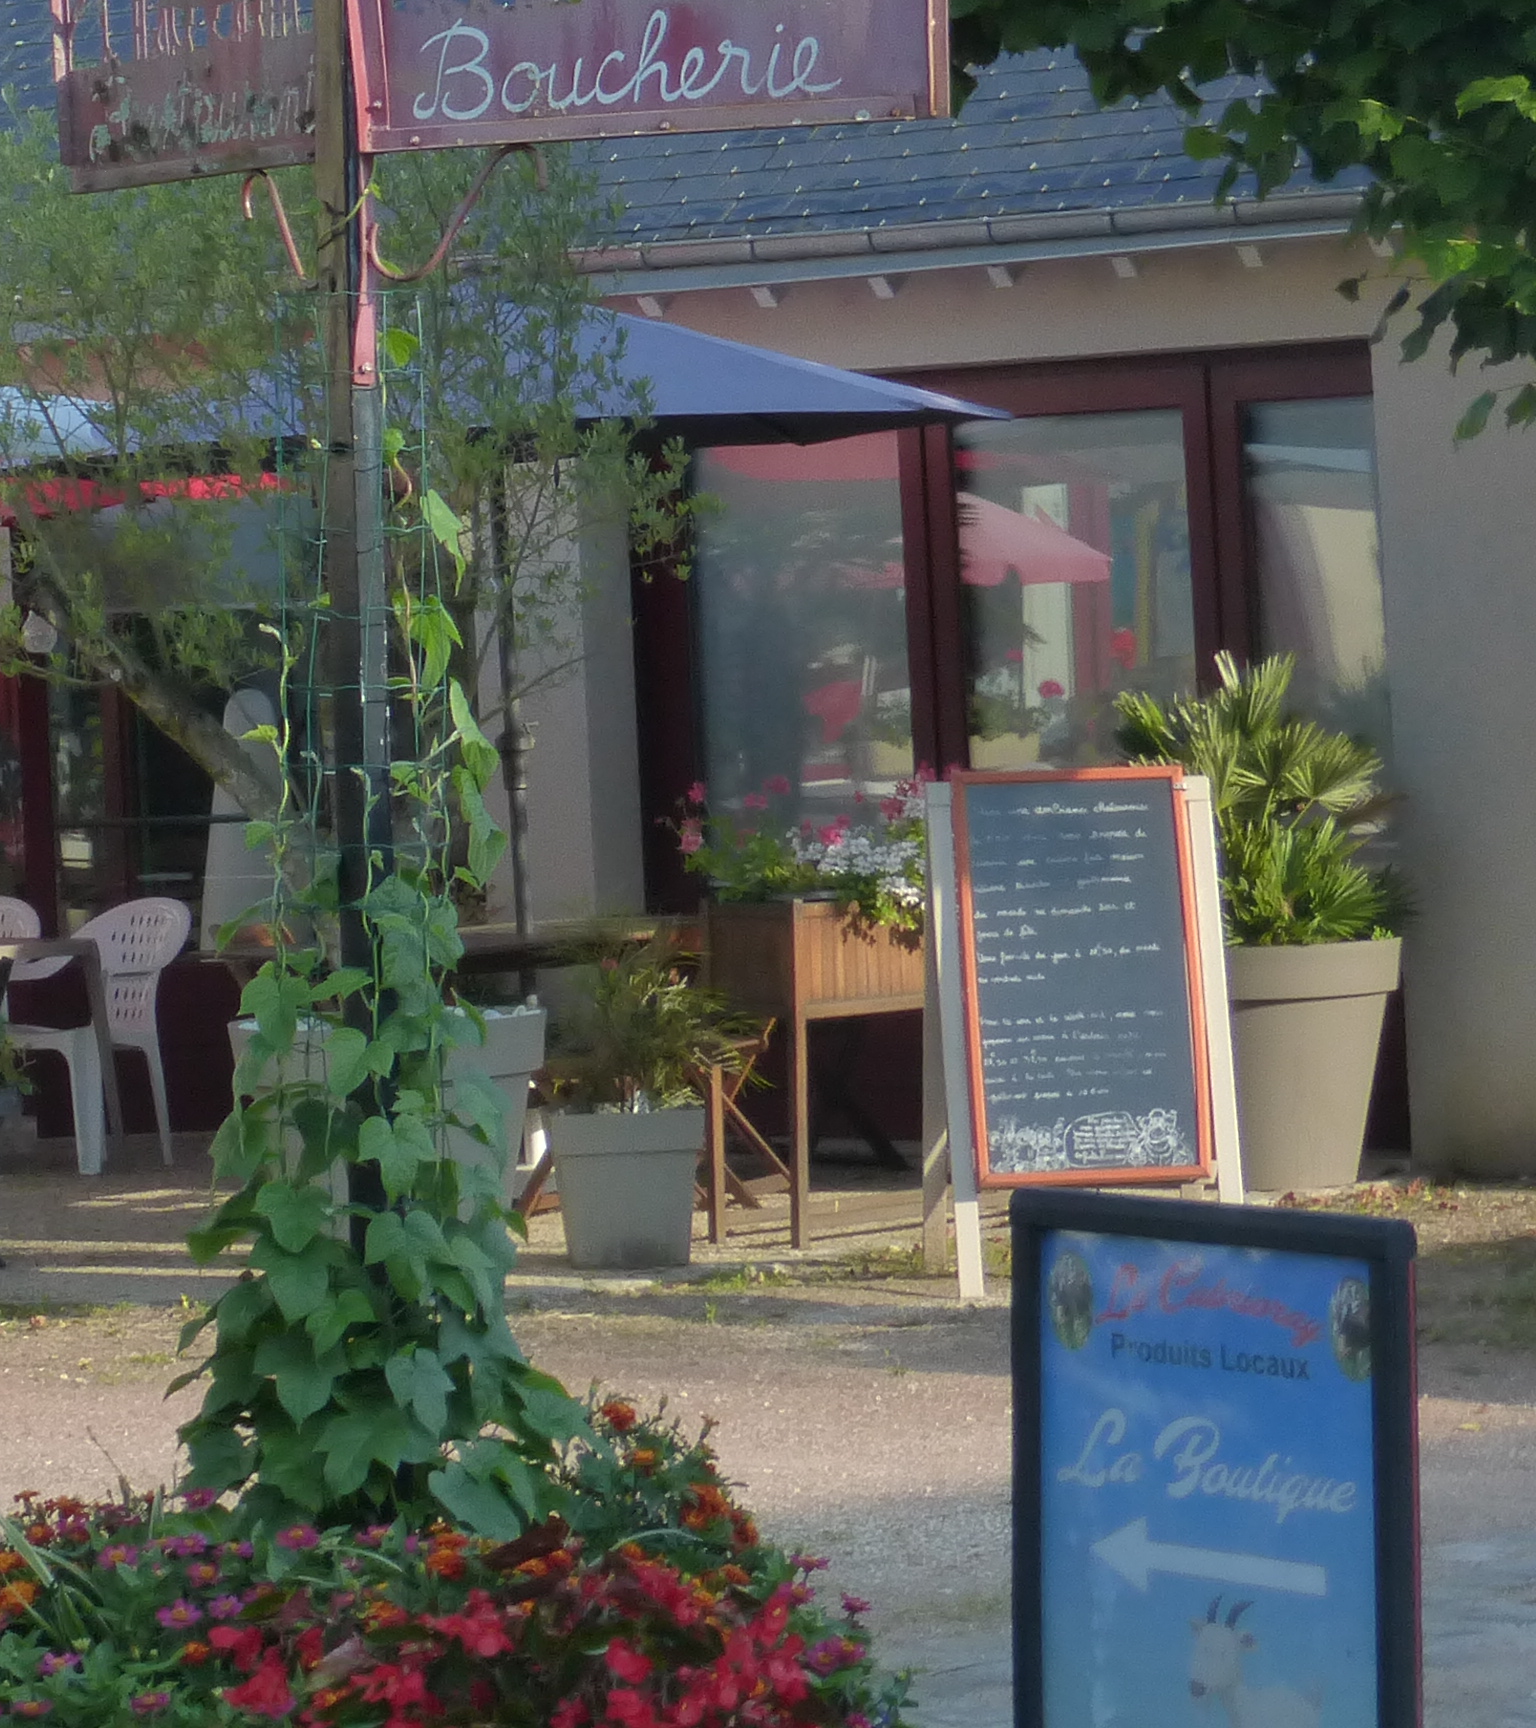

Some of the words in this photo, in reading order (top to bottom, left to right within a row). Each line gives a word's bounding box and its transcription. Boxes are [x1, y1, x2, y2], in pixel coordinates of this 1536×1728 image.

[413, 8, 843, 121] Boucherie
[1110, 1331, 1212, 1369] Produits
[1220, 1342, 1311, 1381] Locaux
[1056, 1408, 1143, 1489] La
[1153, 1415, 1357, 1524] Boutique
